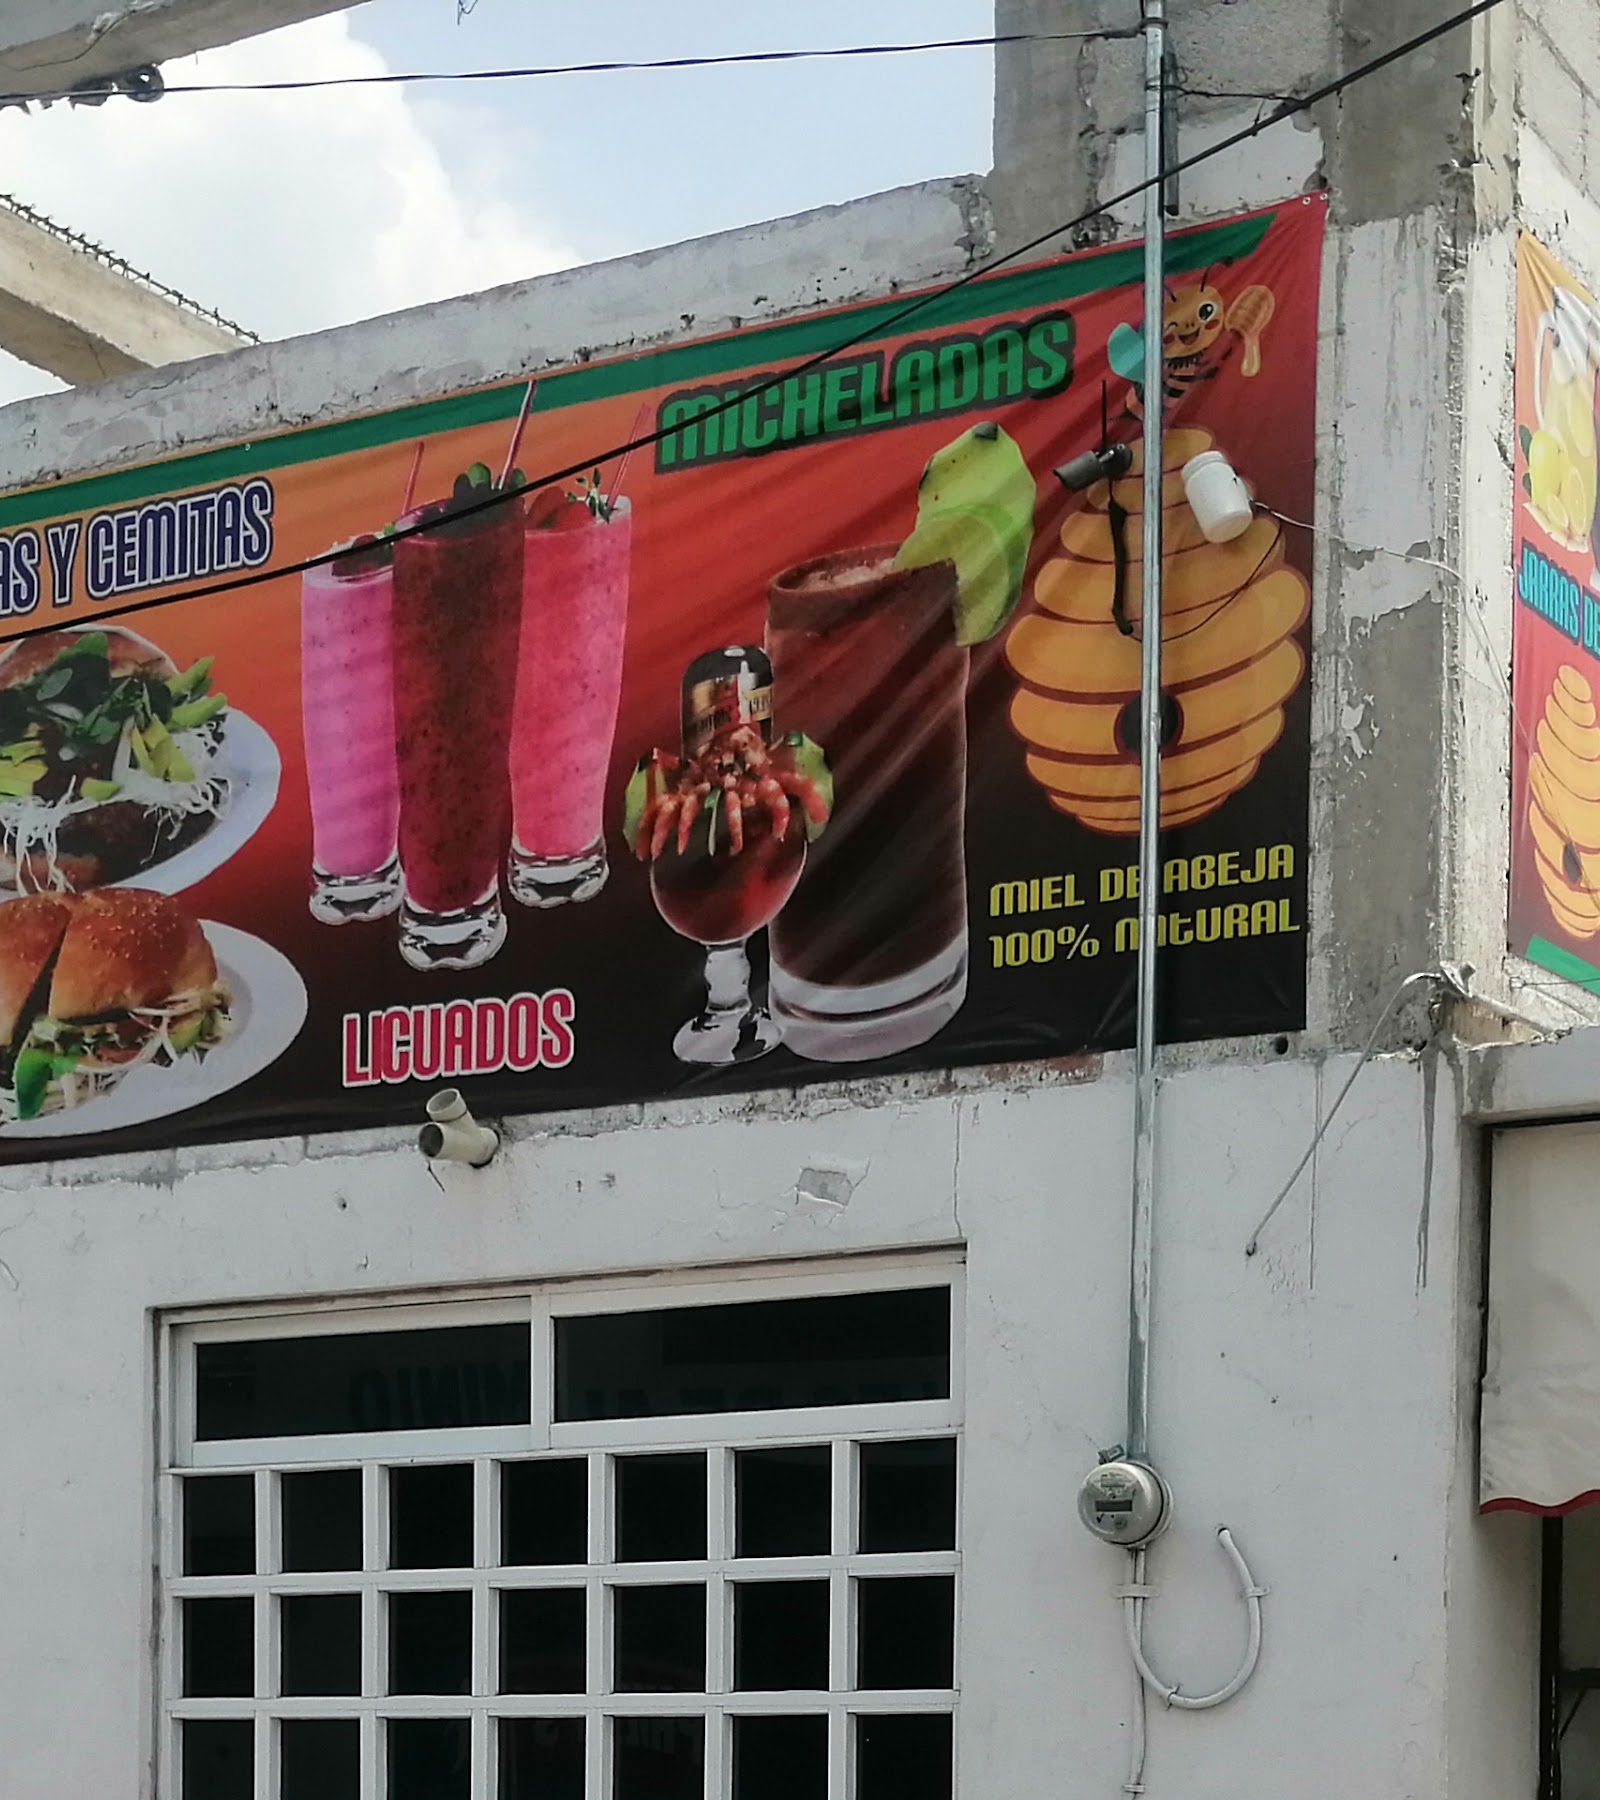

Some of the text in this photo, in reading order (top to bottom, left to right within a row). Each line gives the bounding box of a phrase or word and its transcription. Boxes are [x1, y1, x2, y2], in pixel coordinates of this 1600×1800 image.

[660, 319, 1070, 466] MICHELADAS
[47, 523, 79, 604] Y
[87, 480, 273, 598] CEMITAS
[1518, 547, 1579, 638] JARRAS
[989, 874, 1085, 917] MIEL
[1163, 844, 1295, 894] ABEJA
[989, 923, 1100, 968] 100%
[343, 988, 575, 1088] LICUADOS
